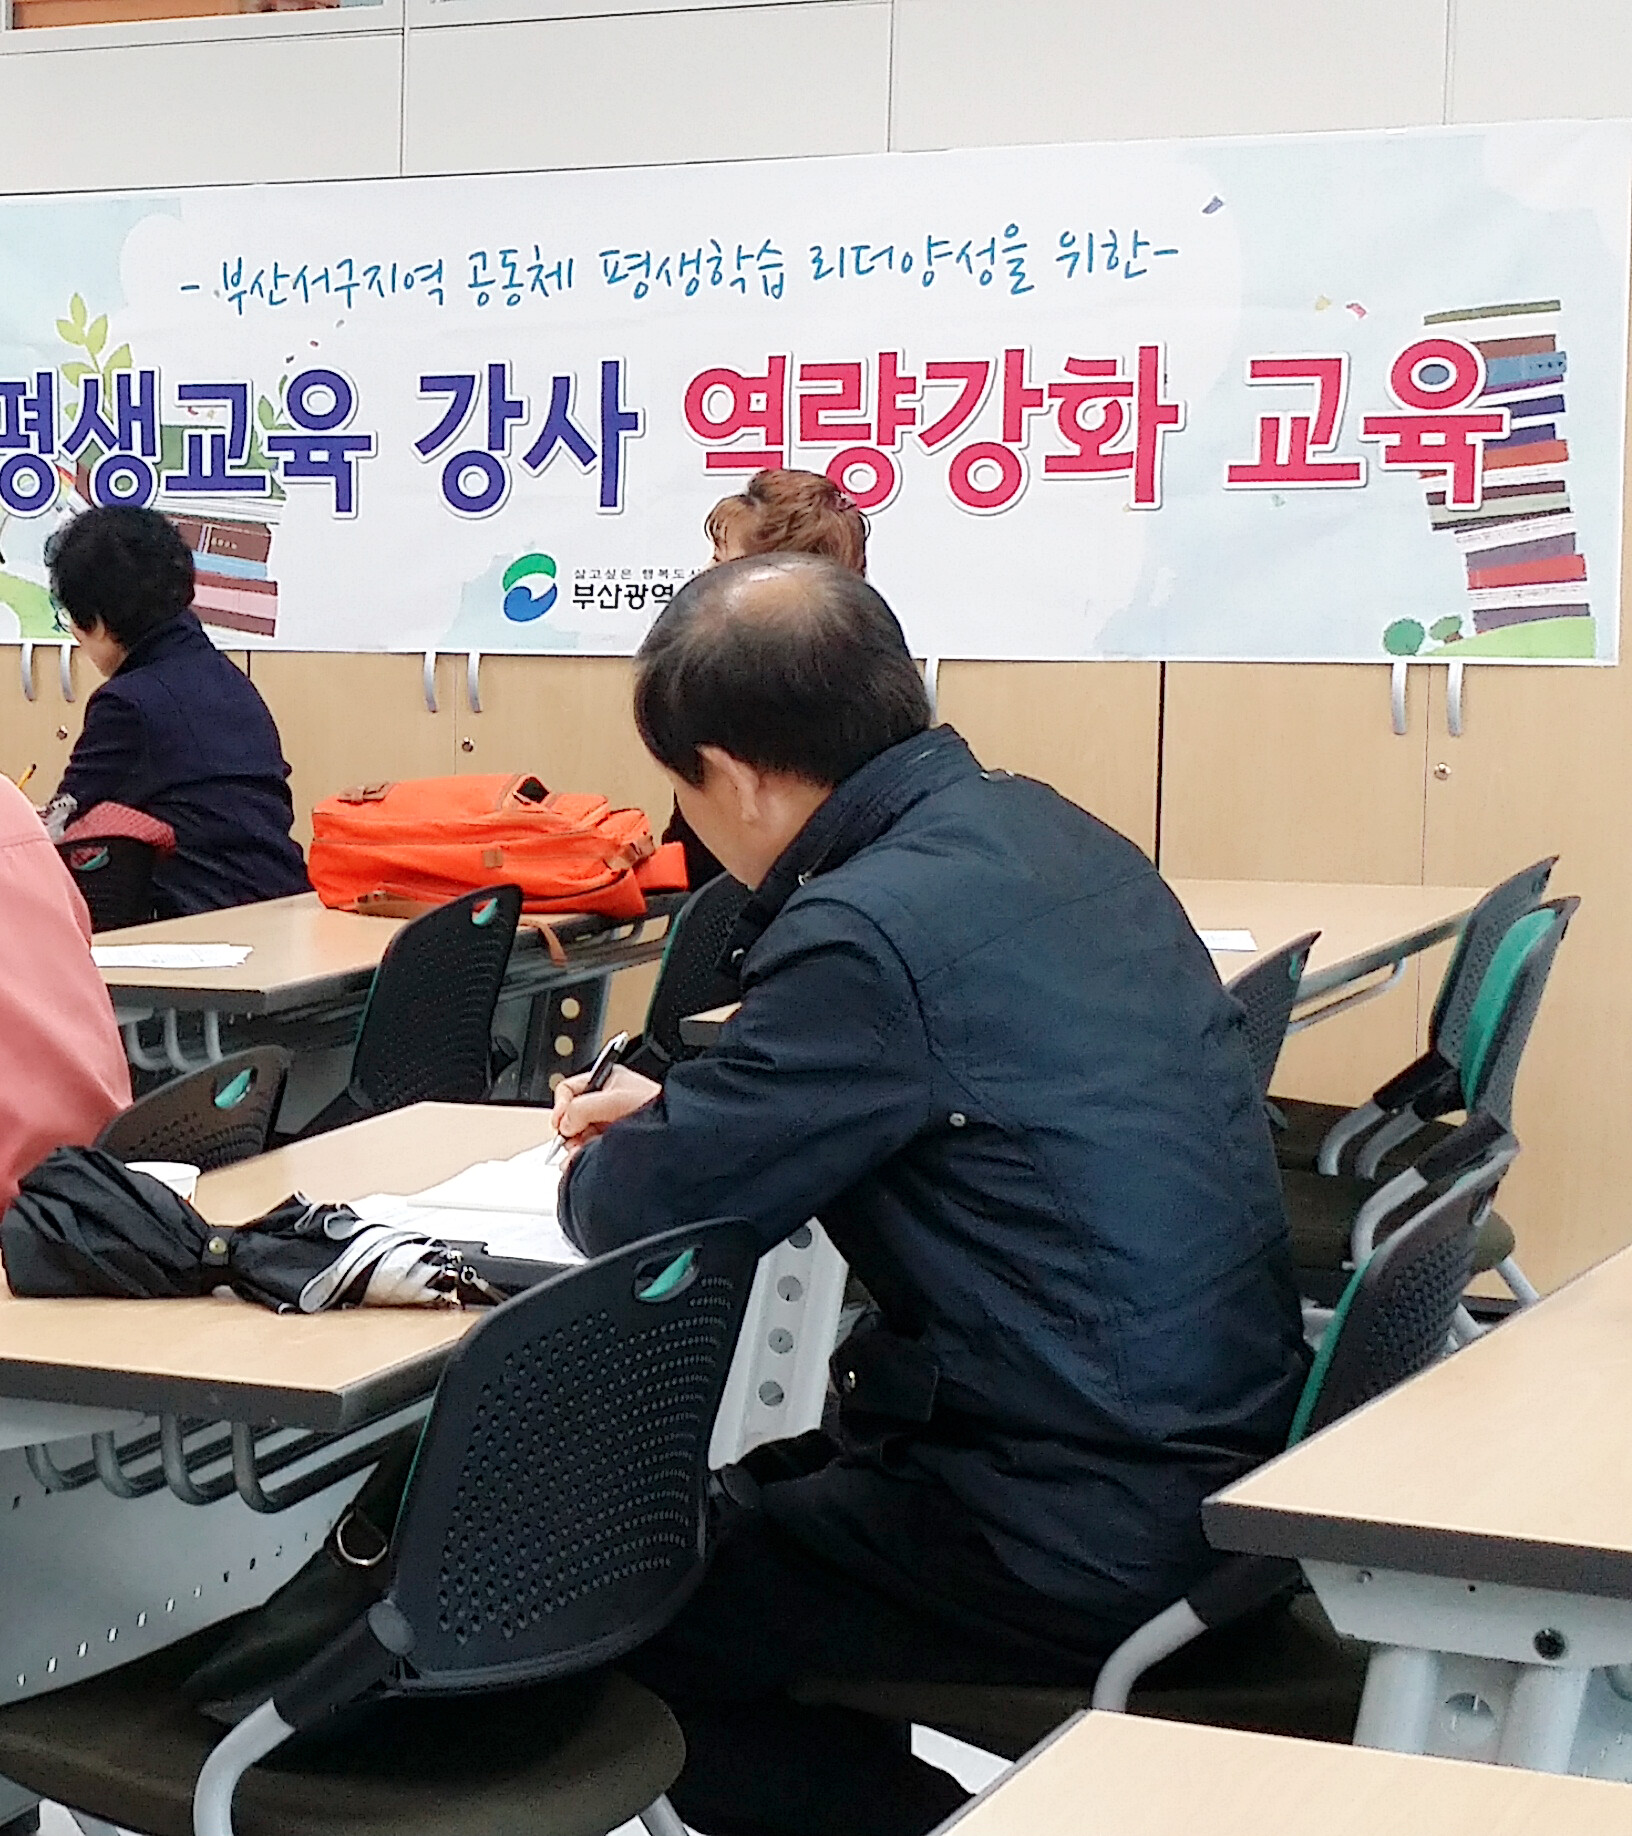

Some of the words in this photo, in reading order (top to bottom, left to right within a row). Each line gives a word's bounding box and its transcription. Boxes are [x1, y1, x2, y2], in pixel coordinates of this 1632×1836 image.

[467, 246, 574, 308] 공동체
[598, 238, 785, 301] 평생학습
[810, 222, 1036, 296] 리더양성을
[414, 360, 641, 514] 강사
[684, 346, 1181, 510] 역량강화
[1227, 338, 1504, 505] 교육
